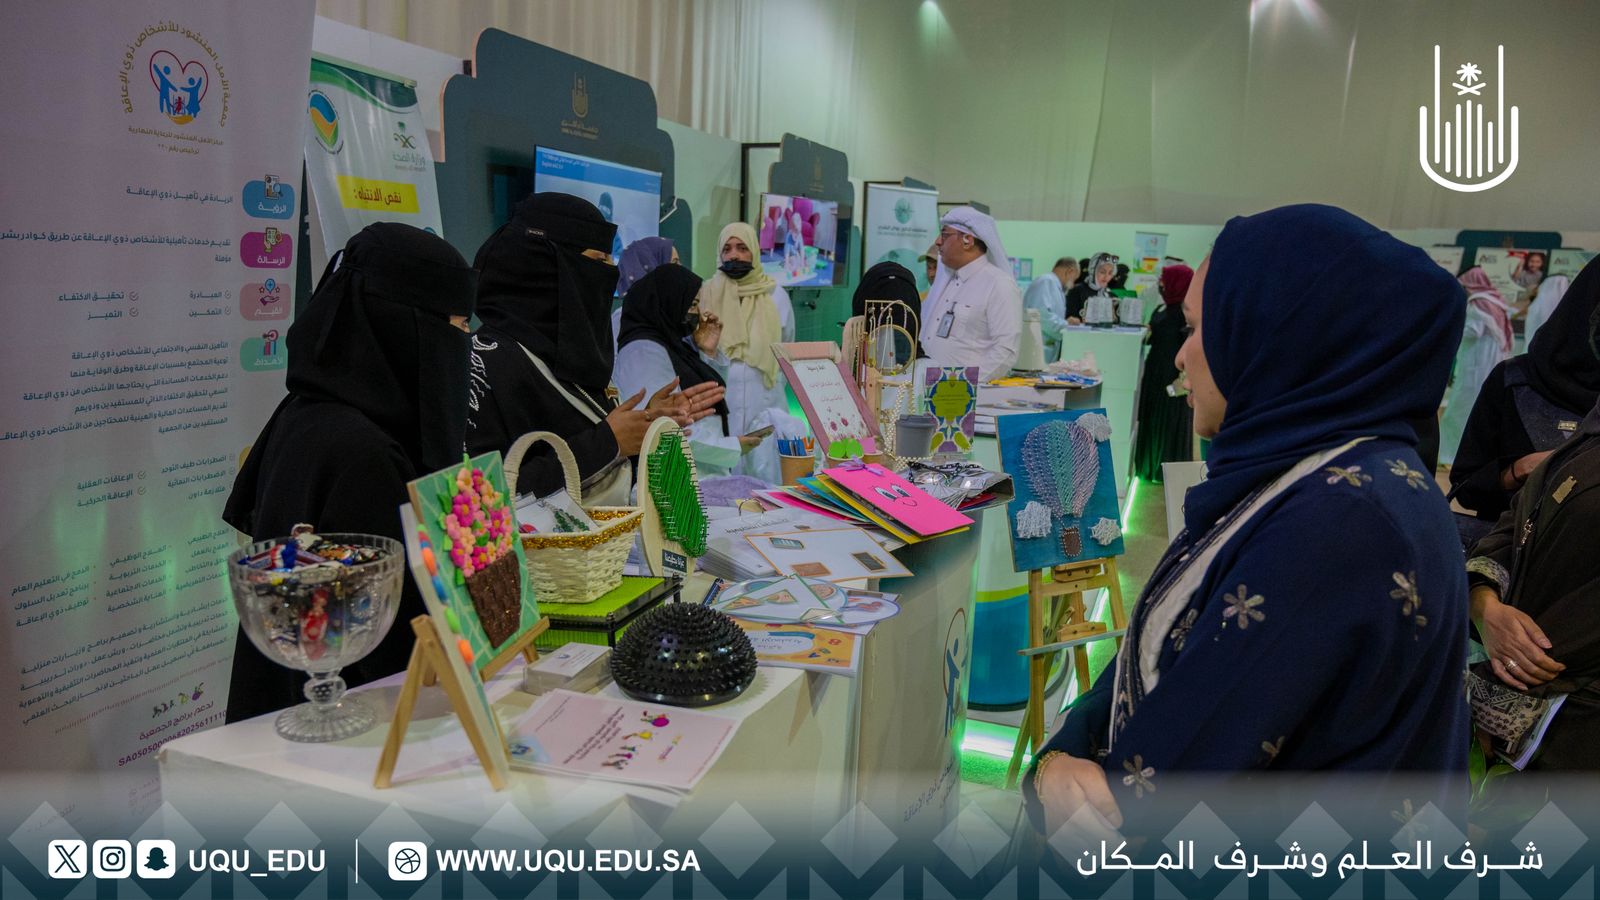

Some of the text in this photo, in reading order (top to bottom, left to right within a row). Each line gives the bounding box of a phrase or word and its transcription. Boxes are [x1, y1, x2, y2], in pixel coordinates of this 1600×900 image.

[135, 20, 180, 48] للأشخاص
[180, 28, 218, 61] المنشود
[124, 46, 136, 70] ذوي
[119, 71, 134, 114] الإعاقة
[126, 186, 233, 204] الريادة في تأهيل ذوي الإعاقة
[384, 192, 402, 205] نقص
[258, 202, 286, 214] الرؤية
[20, 232, 46, 241] كوادر
[47, 232, 70, 242] طريق
[83, 232, 112, 244] الإعاقة
[130, 235, 165, 244] للأشخاص
[166, 235, 187, 246] تأهيلية
[210, 239, 231, 248] تقديم
[215, 254, 231, 263] مؤهلة
[258, 256, 286, 265] الرسالة
[58, 291, 124, 302] تحقيق الاكتفاء
[189, 290, 222, 300] المبادرة
[88, 310, 122, 320] التميز
[189, 309, 222, 318] التمكين
[72, 341, 228, 360] التأهيل النفسي والاجتماعي للأشخاص ذوي الإعاقة
[187, 359, 213, 369] المجتمع
[213, 357, 228, 366] توعية
[87, 367, 112, 377] الوقاية
[113, 365, 134, 375] وطرق
[134, 363, 158, 372] الإعاقة
[116, 381, 144, 390] يحتاجها
[145, 379, 161, 390] التي
[161, 376, 189, 385] المساندة
[82, 383, 114, 395] الأشخاص
[186, 389, 208, 399] لتحقيق
[208, 388, 228, 398] السعي
[23, 391, 52, 401] الإعاقة
[53, 391, 69, 400] ذوي
[145, 395, 163, 407] الذاتي
[74, 403, 100, 415] وذويهم
[101, 397, 144, 410] للمستفيدين
[177, 404, 211, 414] المساعدات
[211, 402, 227, 412] تقديم
[157, 409, 176, 419] المالية
[94, 416, 129, 427] للمحتاجين
[193, 417, 228, 429] المستفيدين
[47, 422, 82, 435] الأشخاص
[158, 424, 182, 434] الجمعية
[29, 430, 46, 440] ذوي
[196, 455, 226, 466] اضطرابات
[161, 464, 179, 474] التوحد
[77, 473, 133, 491] الإعاقات العقلية
[167, 470, 226, 488] الاضطرابات النمائية
[77, 489, 133, 507] الإعاقة الحركية
[191, 542, 229, 558] العلاج بالعمل
[109, 545, 166, 568] العلاج الوظيفي
[109, 560, 166, 581] الخدمات التربوية
[61, 572, 70, 583] في
[33, 576, 60, 591] التعليم
[12, 583, 32, 597] العام
[106, 583, 141, 598] الاجتماعية
[15, 583, 89, 611] برنامج تعديل السلوك
[107, 598, 143, 613] الشخصية
[16, 599, 89, 627] توظيف ذوي الإعاقة
[87, 638, 109, 652] برامج
[21, 660, 51, 675] منزلية
[22, 709, 50, 726] العلمي
[139, 700, 214, 740] لدعم برامج الجمعية
